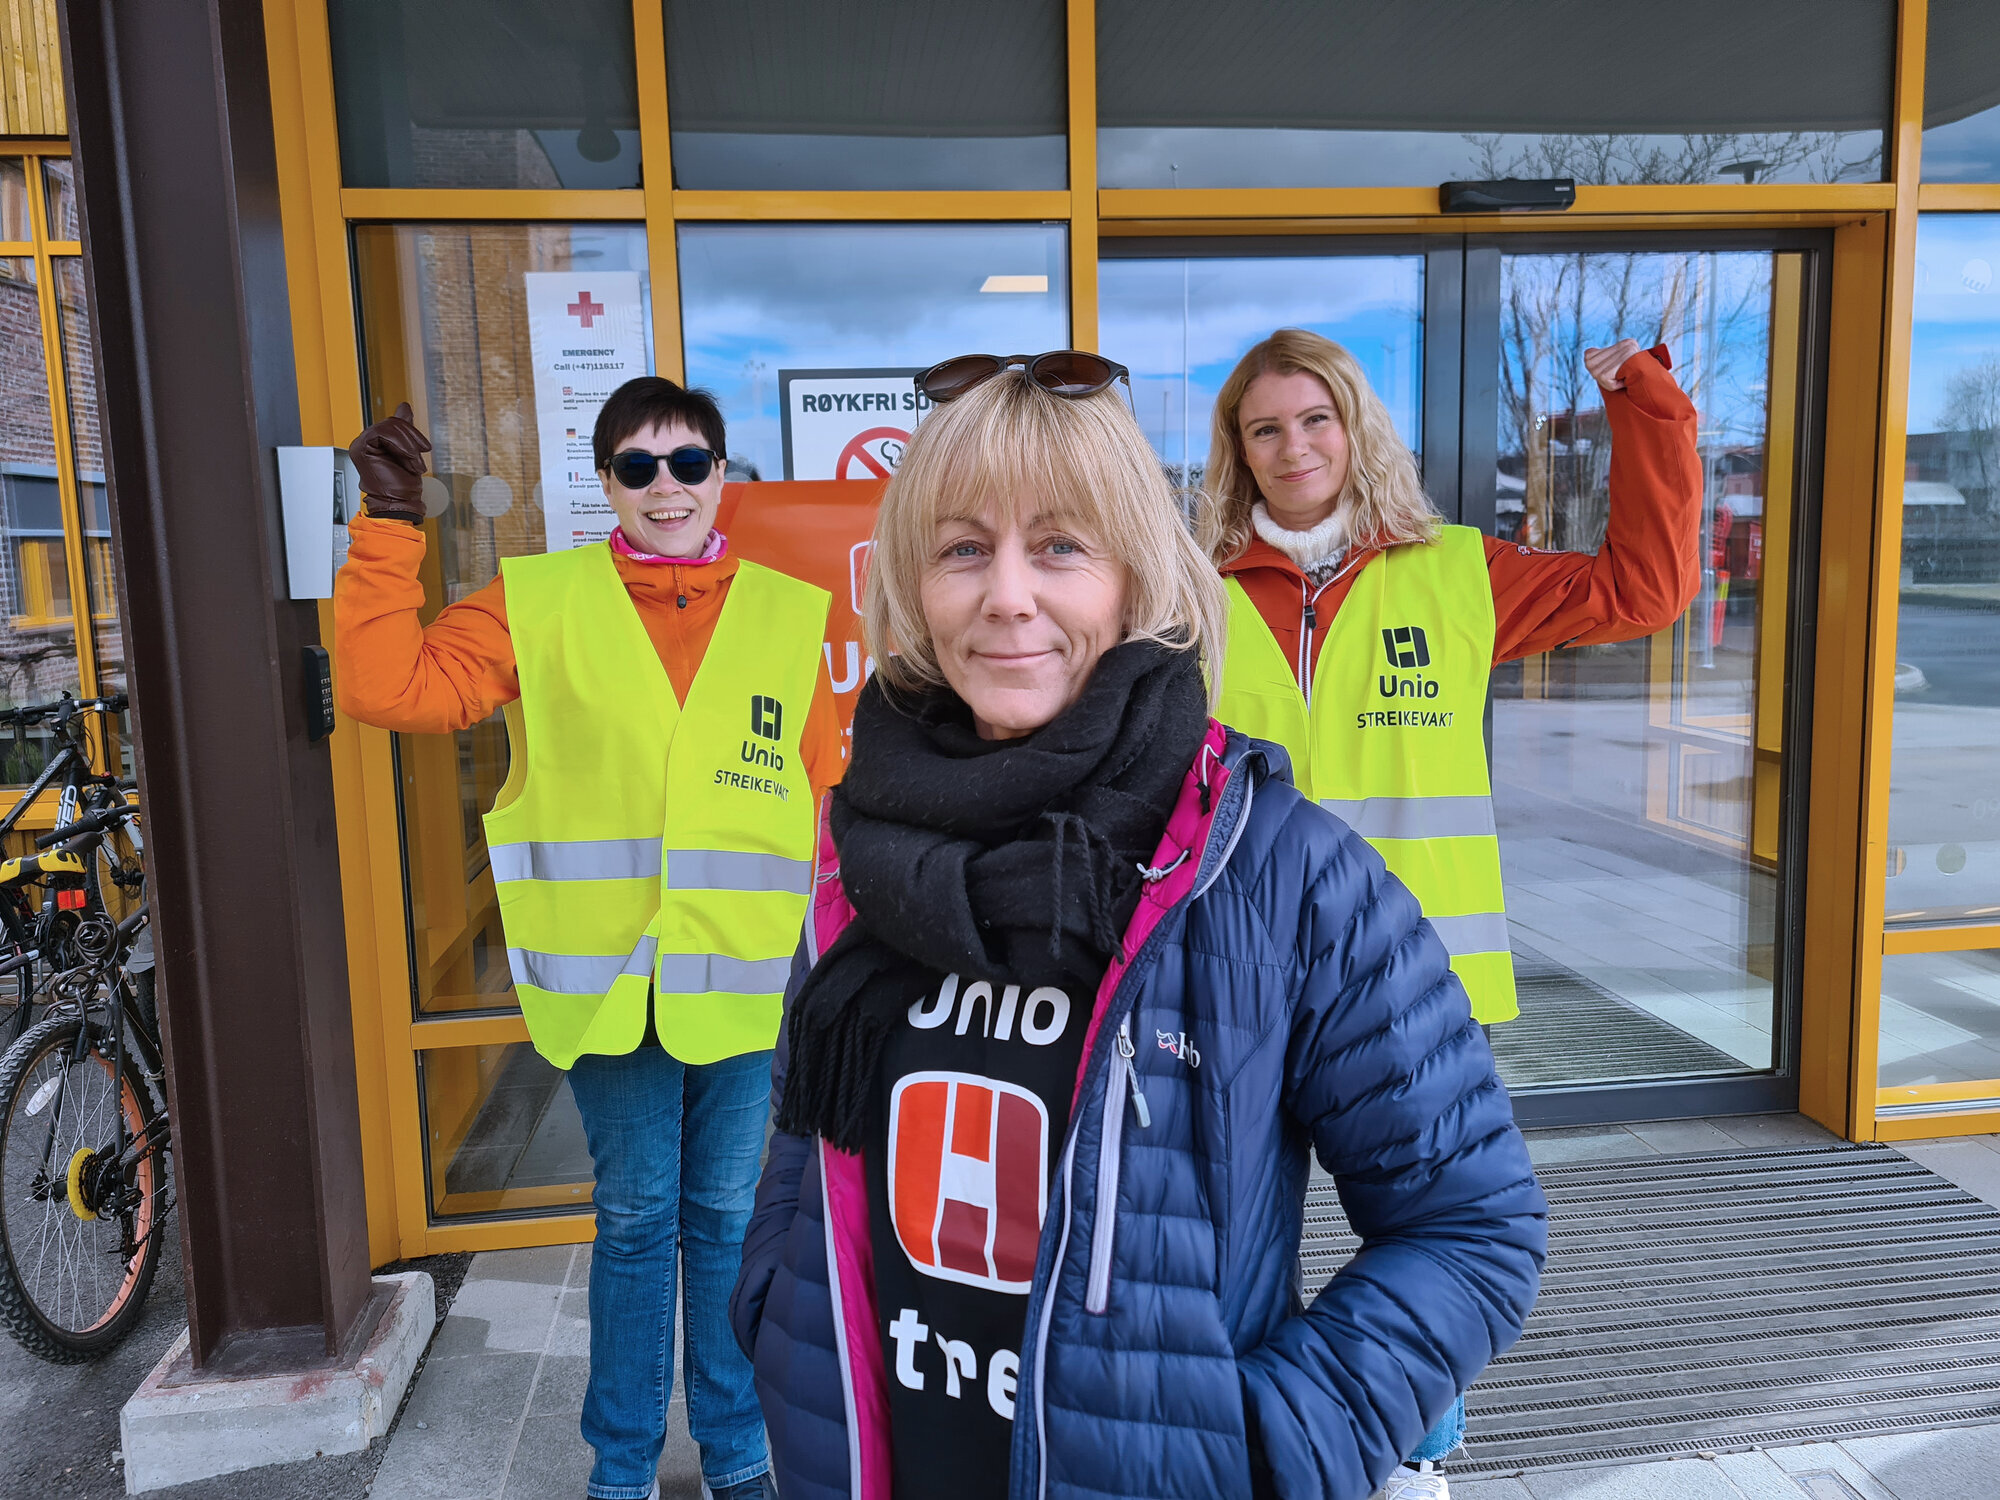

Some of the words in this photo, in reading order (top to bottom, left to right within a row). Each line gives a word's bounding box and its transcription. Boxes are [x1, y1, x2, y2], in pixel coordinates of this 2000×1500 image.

[562, 349, 615, 357] EMERGENCY
[802, 393, 897, 412] RØYKFRI
[903, 392, 936, 410] SO
[1379, 673, 1440, 699] Unio
[1356, 710, 1454, 729] STREIKEVAKT
[741, 740, 784, 772] Unio
[713, 769, 789, 802] STREIKEVAKT
